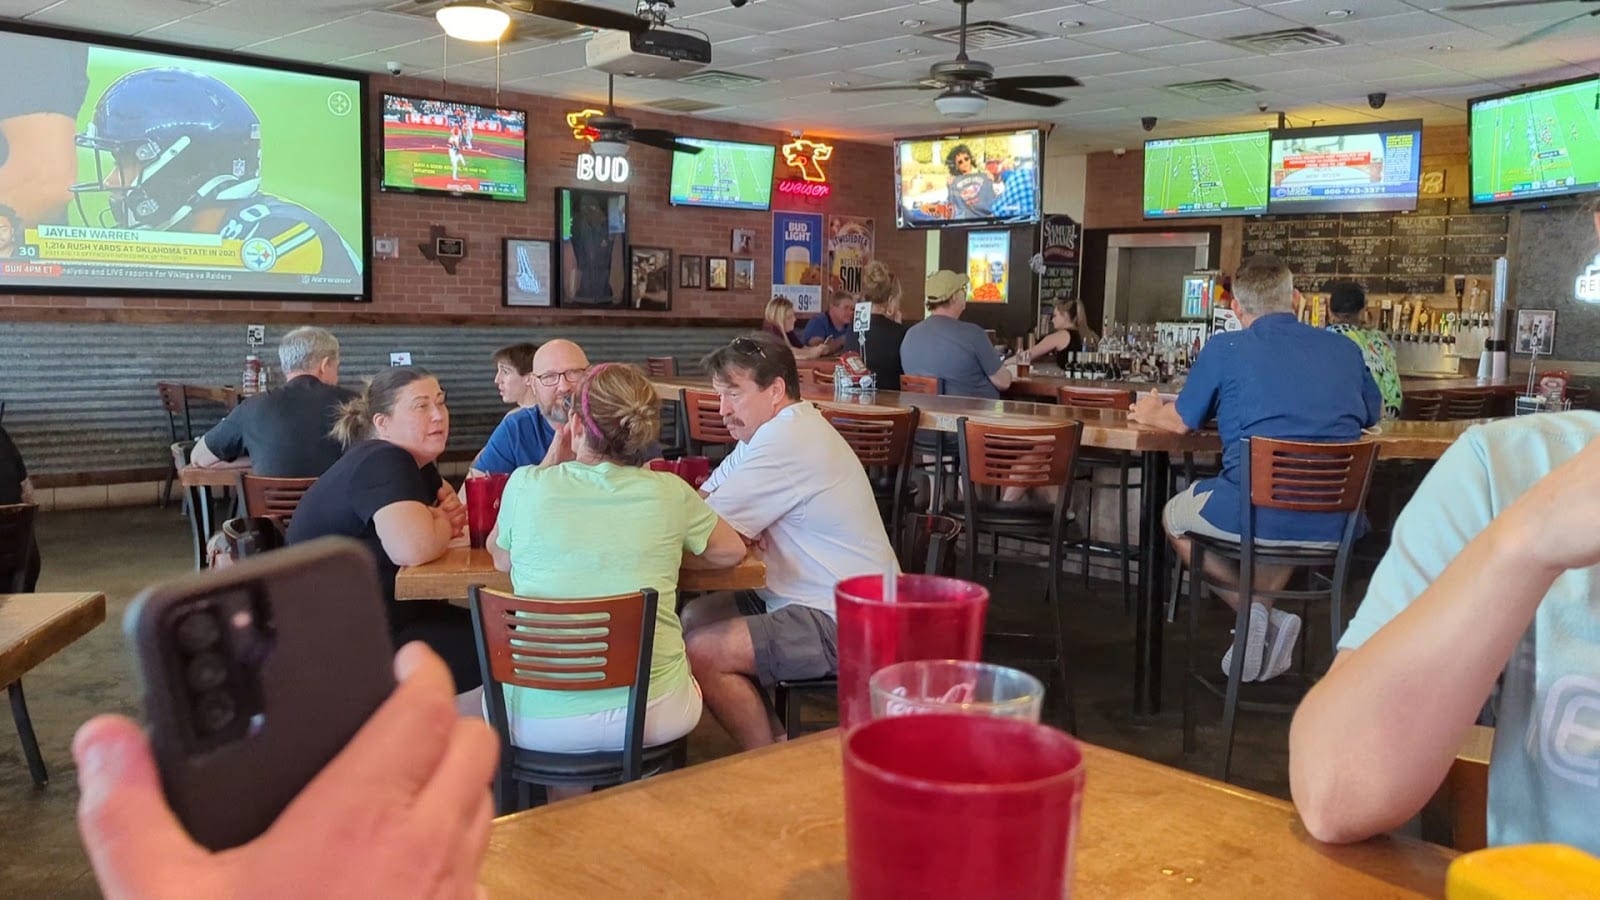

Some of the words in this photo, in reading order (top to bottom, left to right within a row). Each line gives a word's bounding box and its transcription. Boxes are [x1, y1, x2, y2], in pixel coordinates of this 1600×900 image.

[576, 154, 629, 183] BUD
[44, 227, 87, 238] JAYLEN
[90, 229, 139, 241] WARREN
[788, 221, 808, 231] BUD
[1044, 221, 1077, 238] SAMUEL
[785, 230, 811, 241] LIGHT
[1046, 232, 1075, 249] ADAMS
[19, 246, 36, 257] 30
[45, 242, 66, 250] 1,216
[67, 243, 91, 251] RUSH
[93, 244, 121, 252] YARDS
[123, 245, 134, 253] AT
[136, 246, 181, 255] OKLAHOMA
[183, 248, 208, 256] STATE
[209, 249, 217, 257] IN
[219, 249, 236, 258] 2021
[23, 264, 41, 273] 4PM
[43, 265, 53, 274] ET
[62, 267, 88, 277] nalysis
[106, 269, 123, 277] LIVE
[155, 270, 166, 278] for
[167, 271, 194, 280] Vikings
[840, 266, 862, 293] SON
